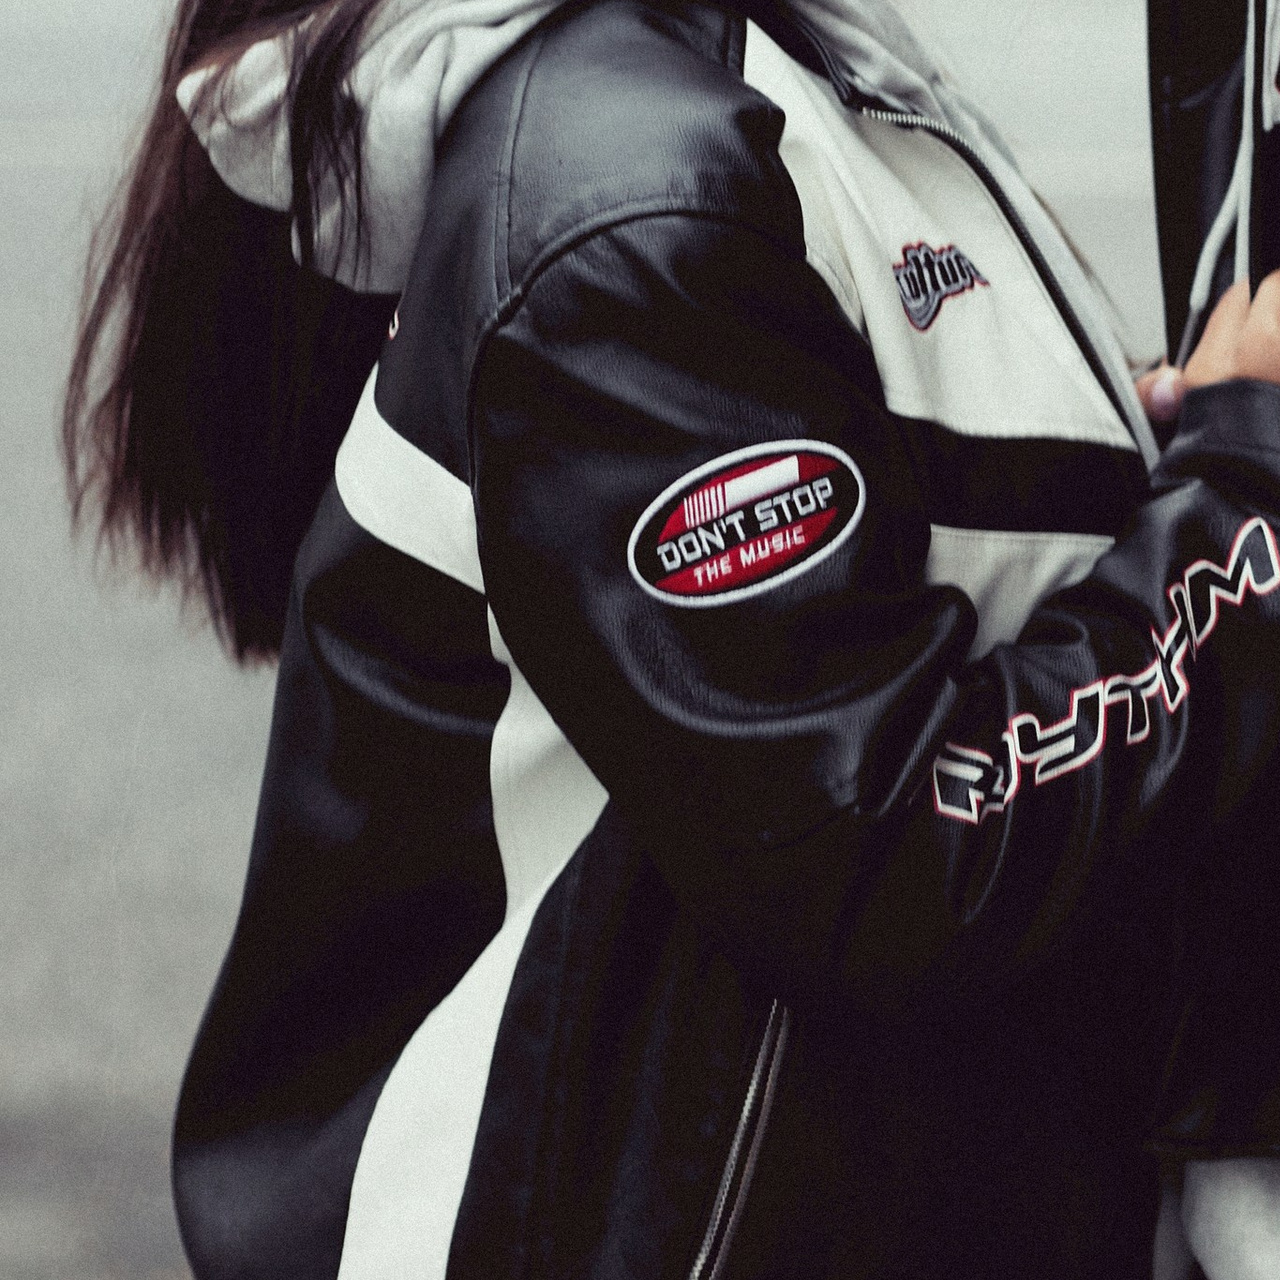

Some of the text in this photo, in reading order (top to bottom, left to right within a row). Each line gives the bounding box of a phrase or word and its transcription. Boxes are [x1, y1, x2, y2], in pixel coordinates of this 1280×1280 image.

[656, 476, 834, 573] DON'T STOP
[693, 523, 806, 588] THE MUSIC
